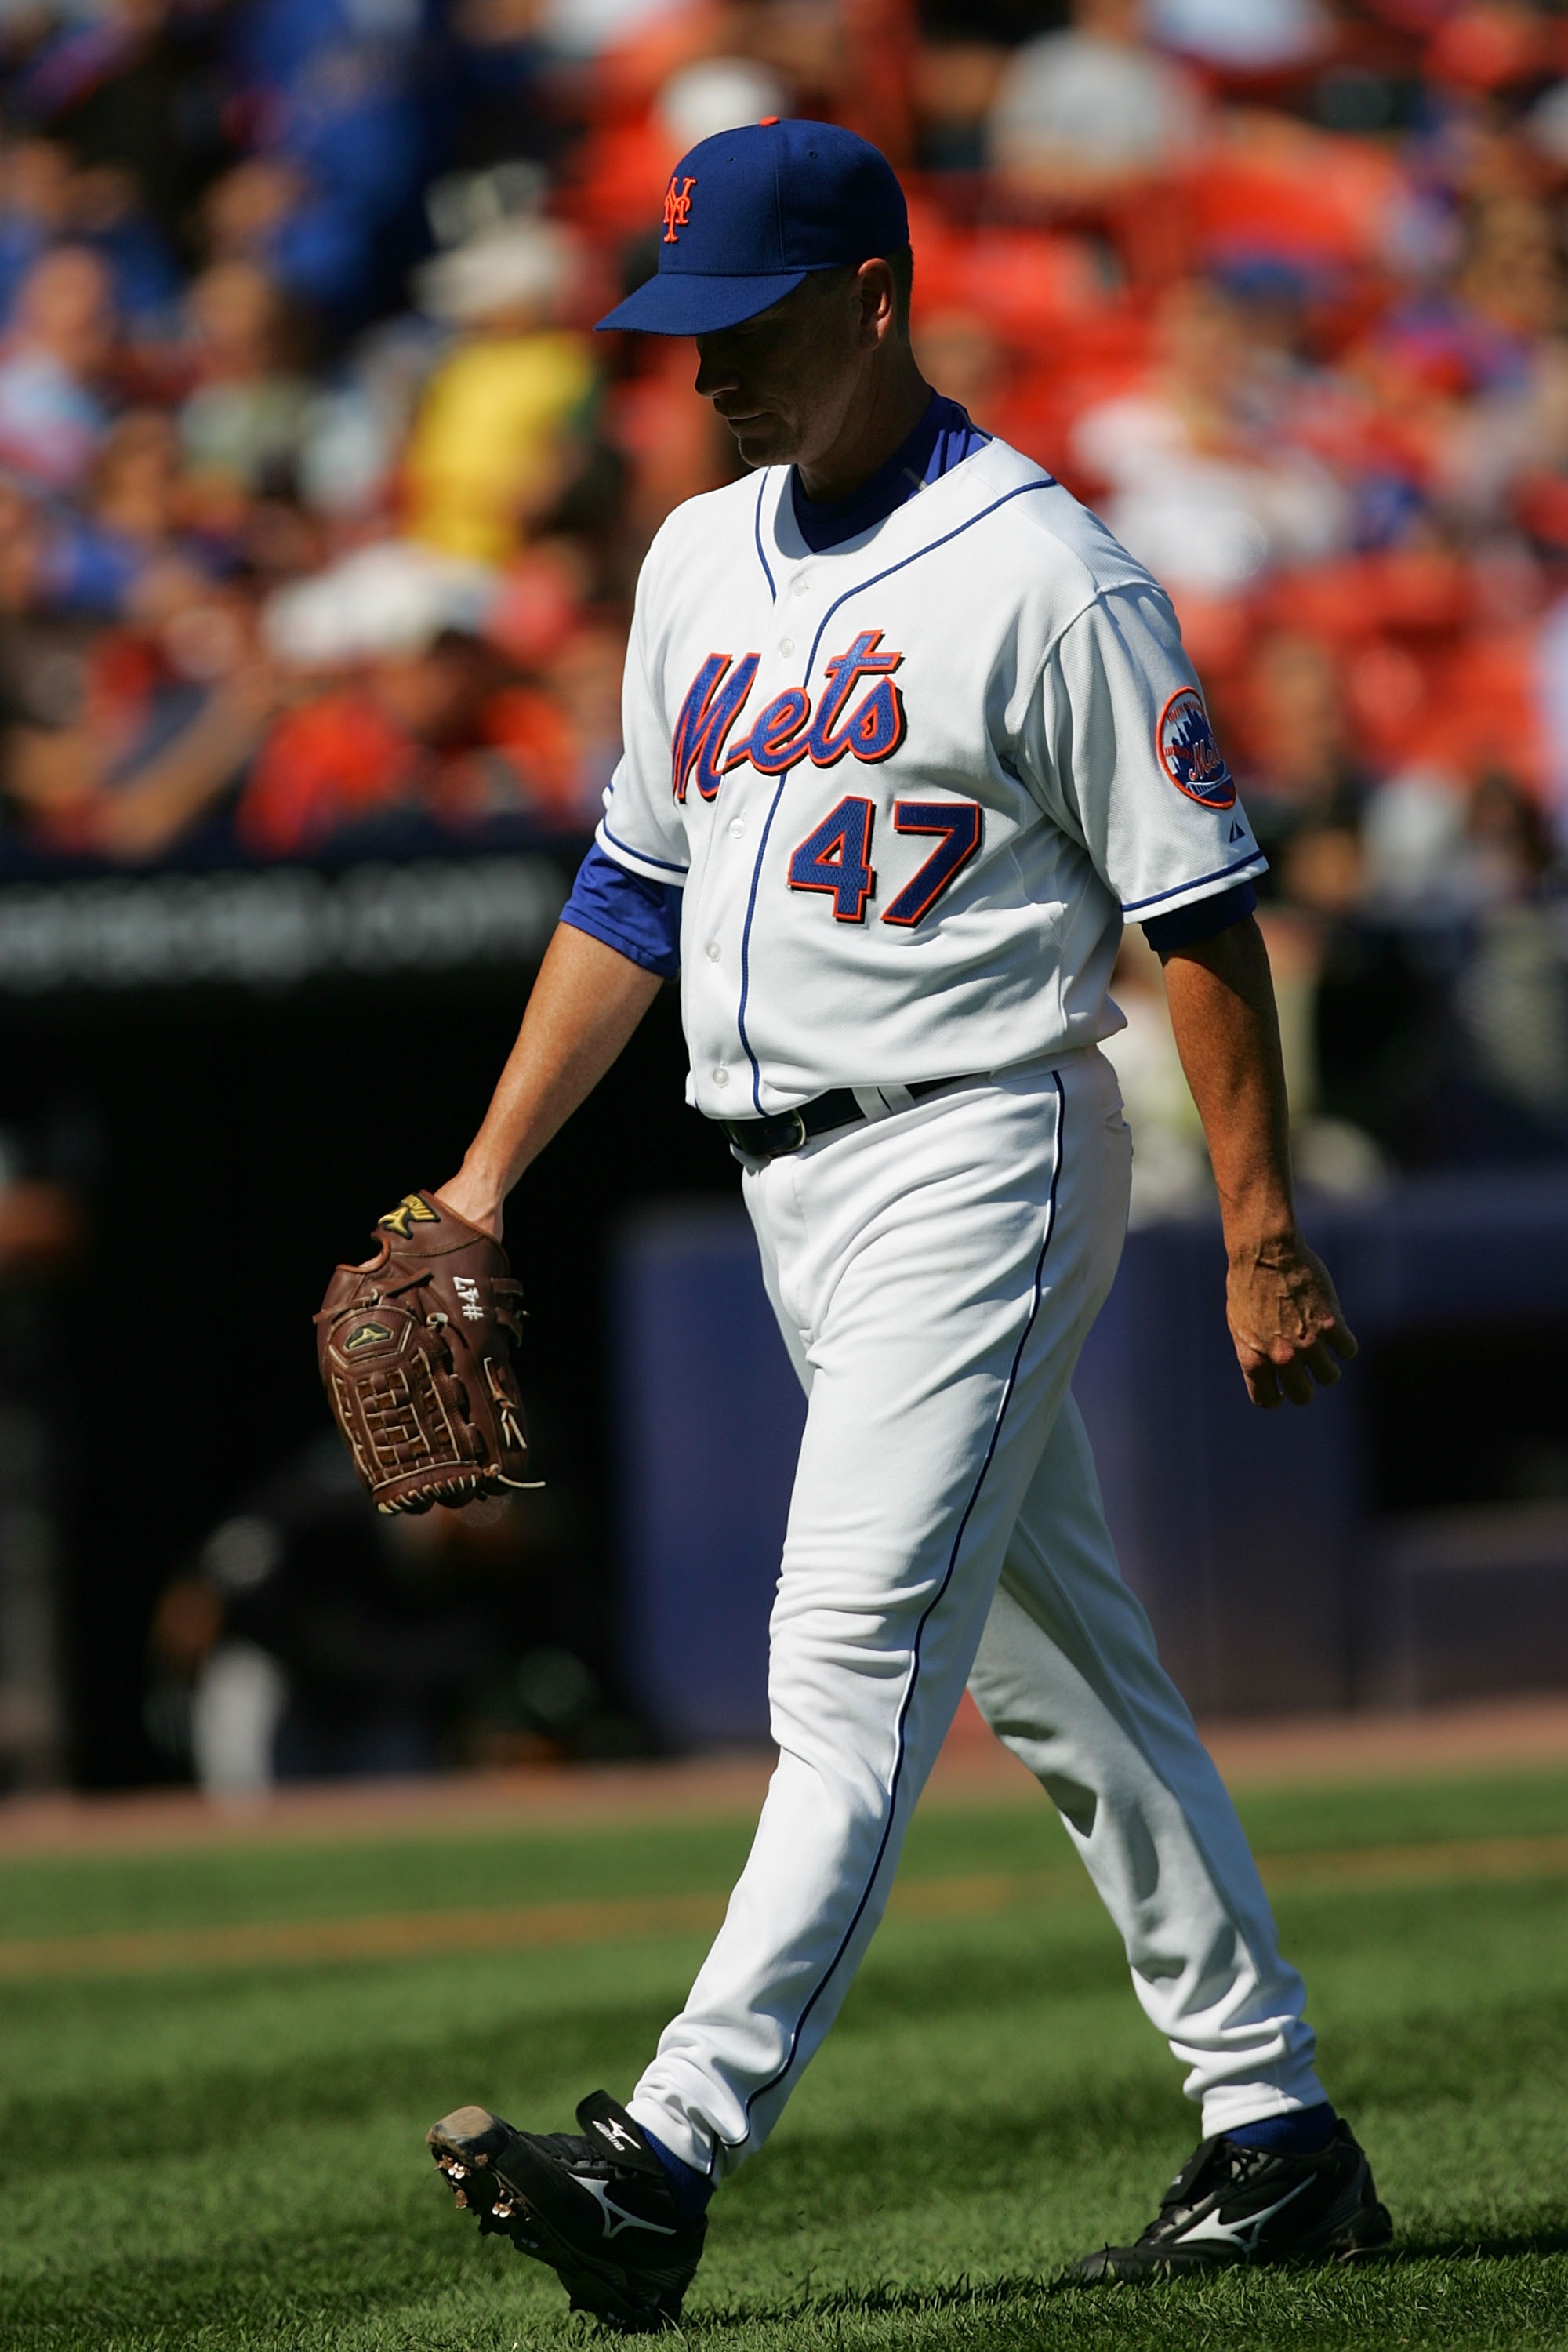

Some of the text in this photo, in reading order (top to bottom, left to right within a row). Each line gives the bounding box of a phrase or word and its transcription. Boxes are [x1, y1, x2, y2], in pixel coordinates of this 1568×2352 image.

[664, 176, 696, 243] NY
[672, 629, 907, 803] Mets
[787, 795, 983, 929] 47
[452, 1276, 484, 1321] #47
